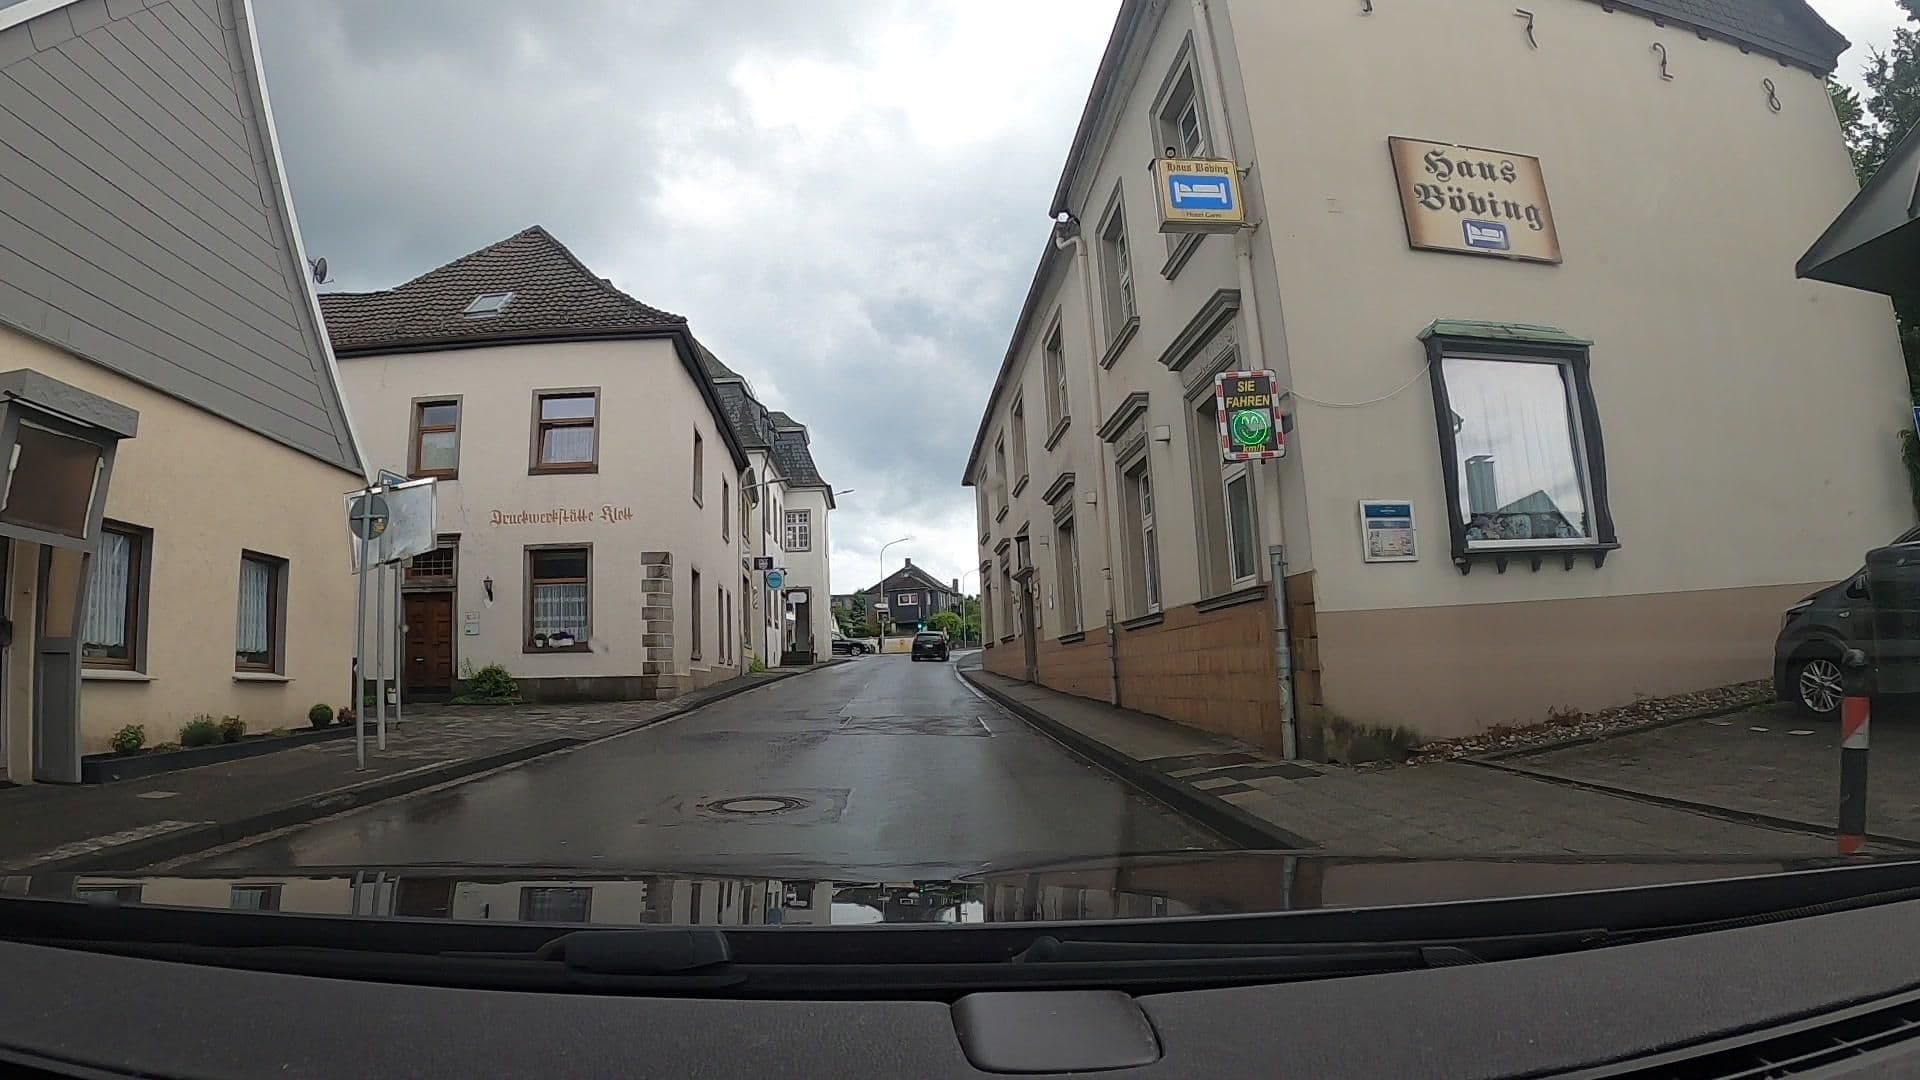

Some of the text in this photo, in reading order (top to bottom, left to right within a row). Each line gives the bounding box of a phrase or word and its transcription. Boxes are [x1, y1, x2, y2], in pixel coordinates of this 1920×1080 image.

[1166, 162, 1229, 174] Haus Böving
[1423, 149, 1517, 184] Haus
[1413, 182, 1544, 231] Böving
[1237, 380, 1256, 393] SIE
[1226, 395, 1270, 409] FAHREN
[1243, 444, 1266, 453] km/h
[600, 505, 634, 524] Klett
